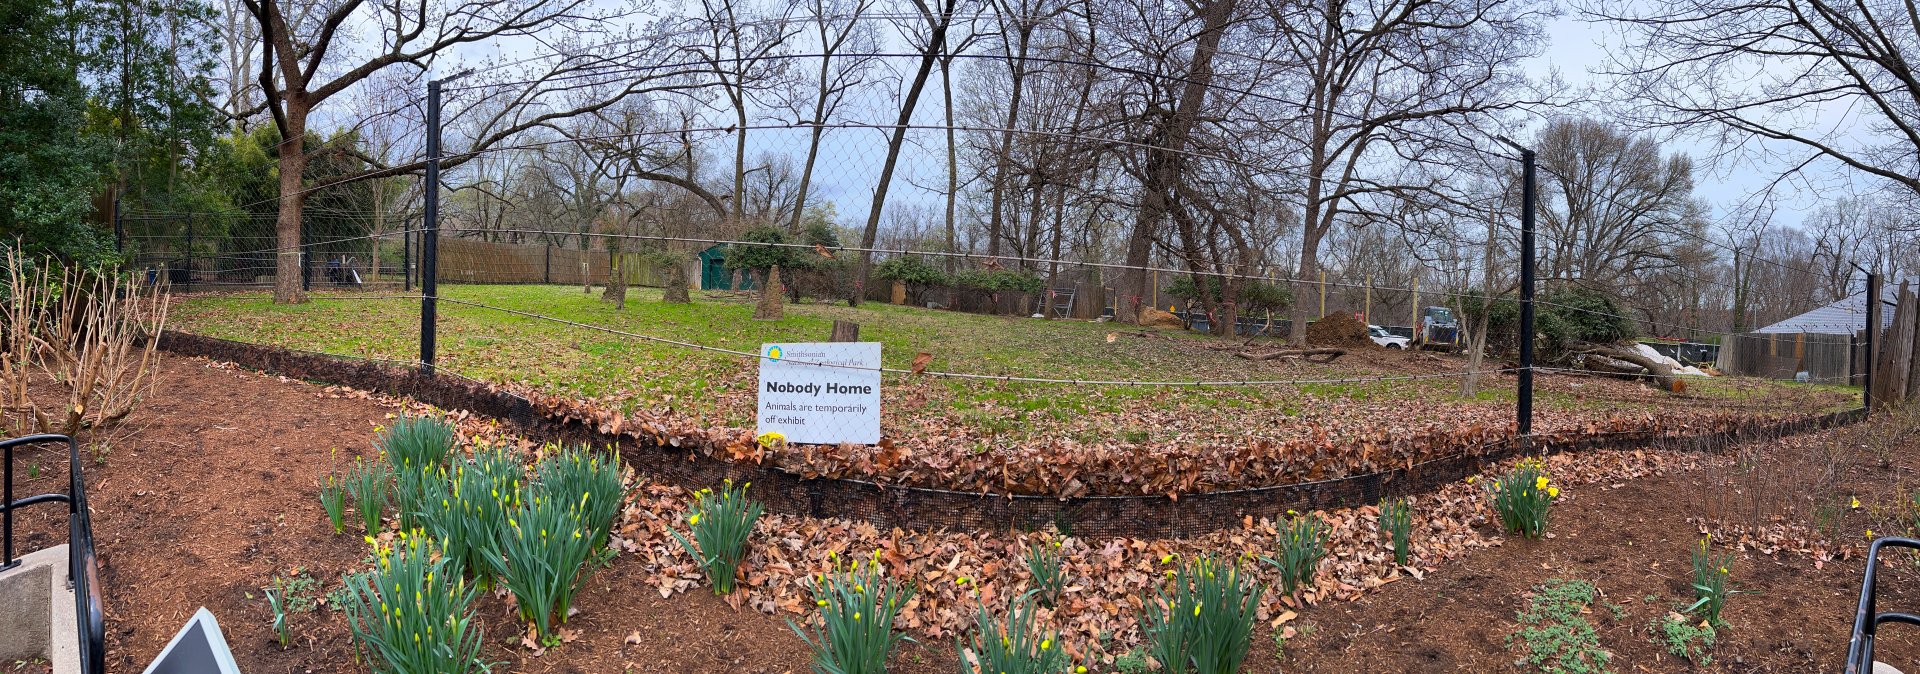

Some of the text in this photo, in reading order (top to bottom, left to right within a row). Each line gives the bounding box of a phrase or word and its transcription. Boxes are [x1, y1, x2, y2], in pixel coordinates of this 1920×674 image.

[786, 350, 826, 358] Smithsonian
[848, 358, 864, 367] Park
[766, 382, 872, 397] Nobody Home
[765, 401, 797, 411] Animals
[815, 403, 867, 415] temporarily
[765, 415, 805, 425] off exhibit
